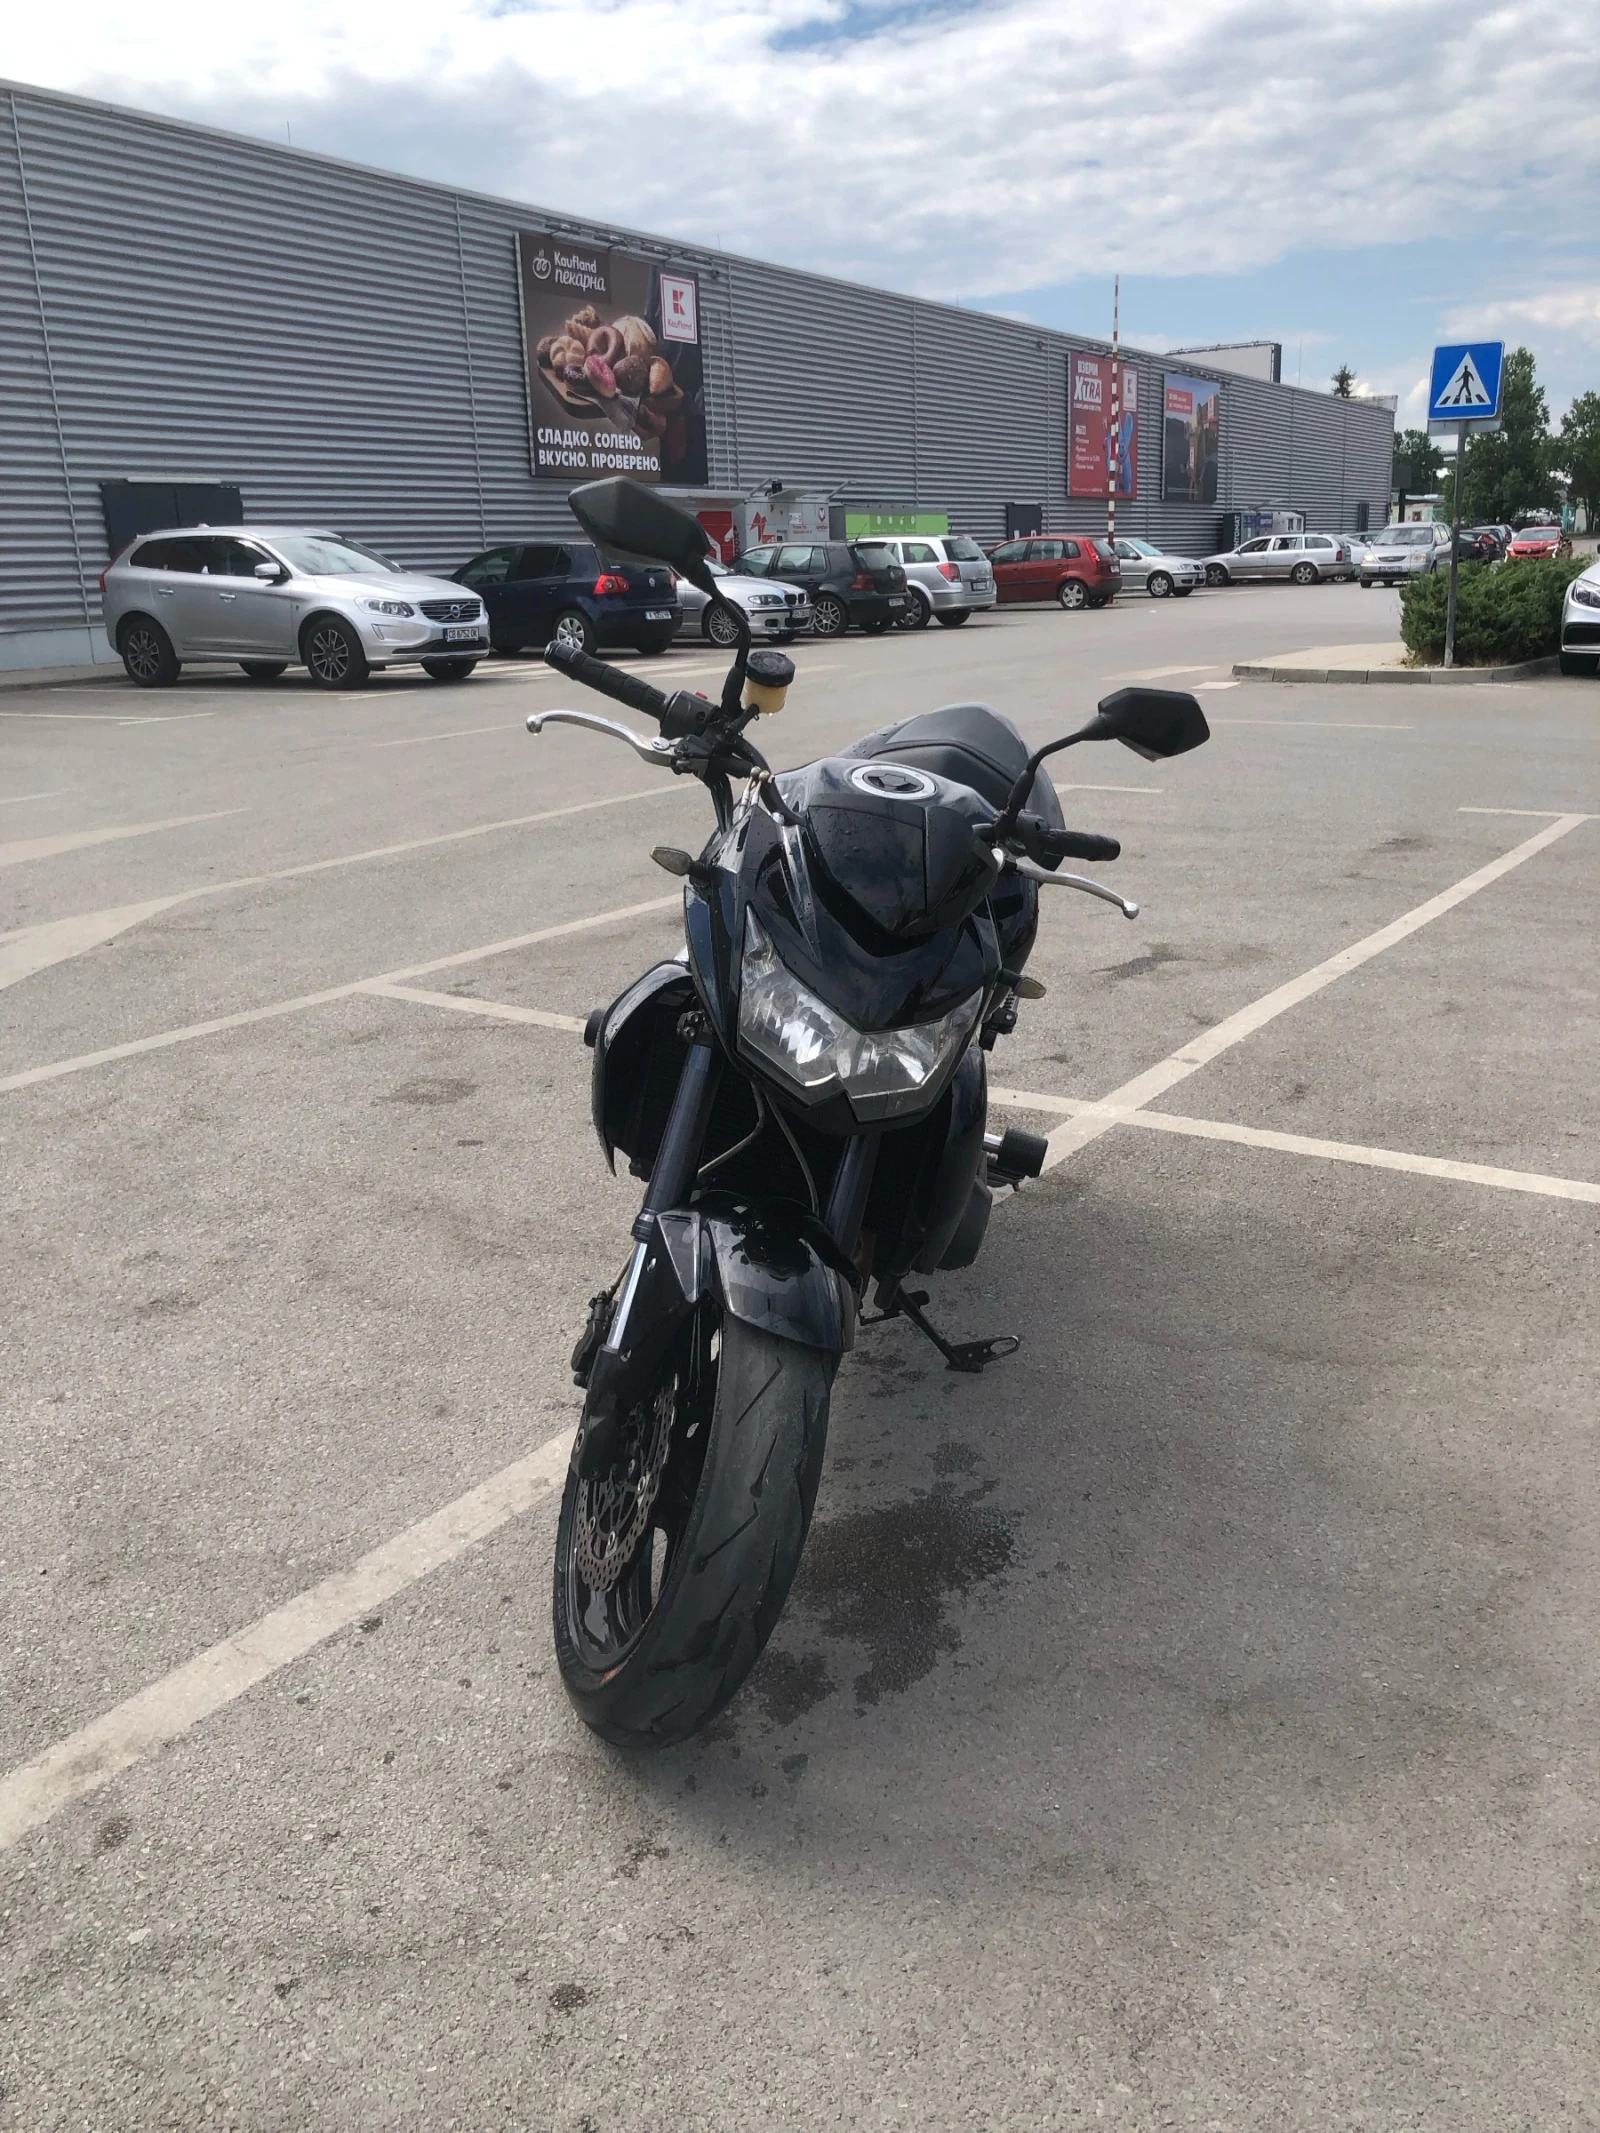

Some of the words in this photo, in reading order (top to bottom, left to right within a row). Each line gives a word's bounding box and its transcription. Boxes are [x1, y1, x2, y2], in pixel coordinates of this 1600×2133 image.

[554, 251, 597, 273] Kaufland
[555, 268, 606, 292] пекарна
[537, 428, 592, 448] СЛАДКО.
[594, 432, 644, 451] СОЛЕНО.
[538, 449, 589, 468] ВКУСНО.
[591, 450, 661, 472] ПРОВЕРЕНО.
